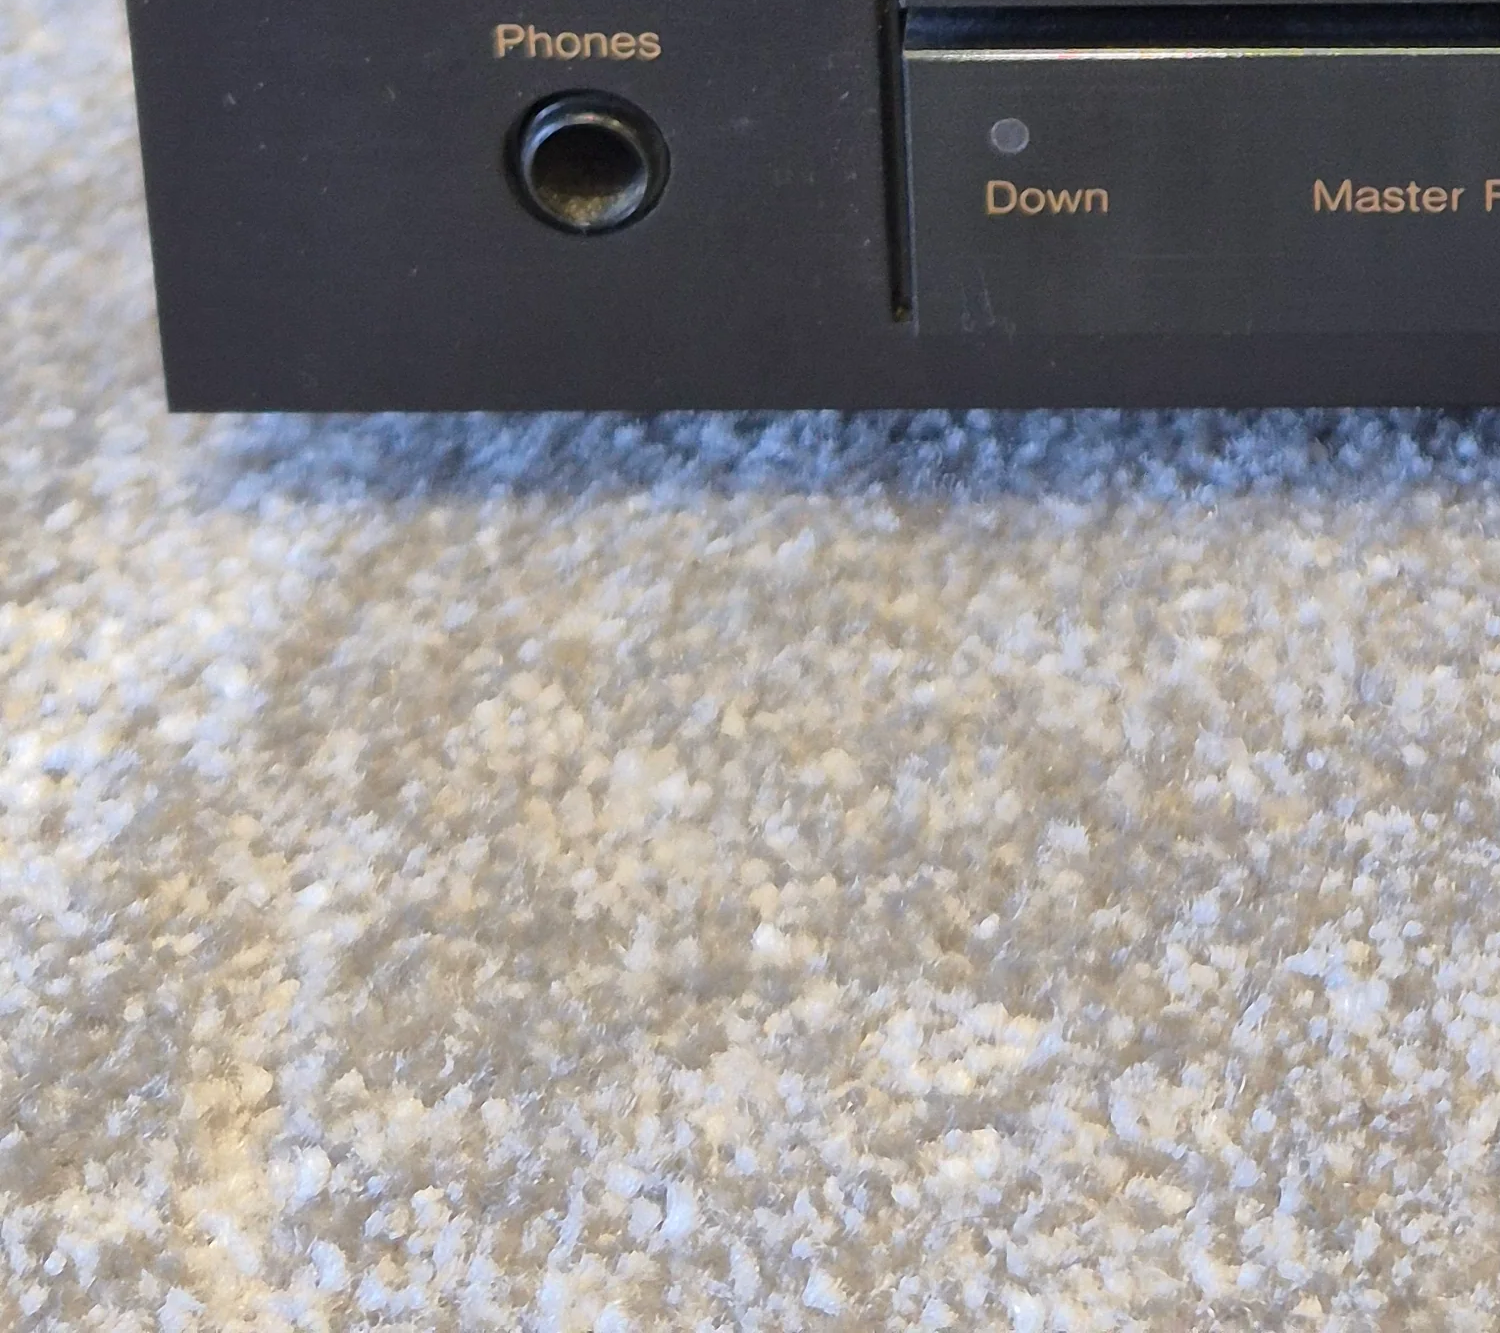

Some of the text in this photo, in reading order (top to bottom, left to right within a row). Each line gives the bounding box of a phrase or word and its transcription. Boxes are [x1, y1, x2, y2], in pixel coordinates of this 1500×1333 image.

[493, 23, 662, 62] Phones
[986, 180, 1108, 216] Down
[1313, 179, 1465, 216] Master
